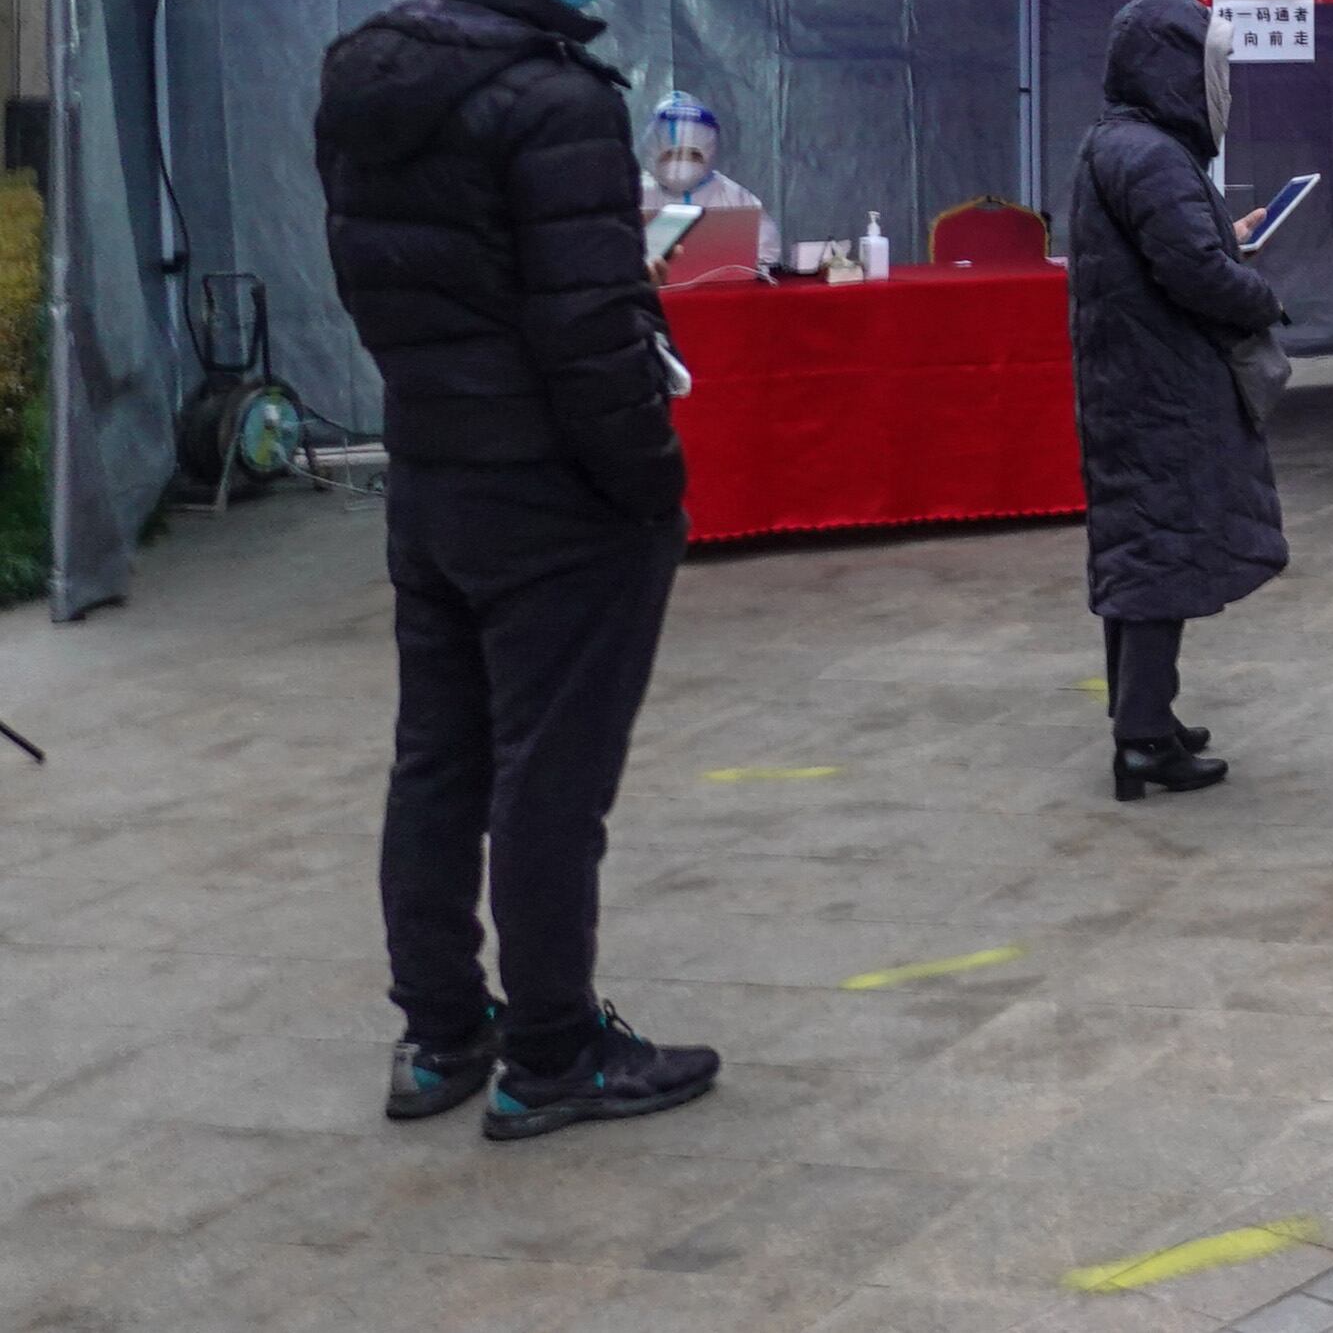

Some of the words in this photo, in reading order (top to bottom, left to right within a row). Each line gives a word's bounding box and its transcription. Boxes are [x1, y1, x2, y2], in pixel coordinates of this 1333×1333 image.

[1219, 6, 1309, 22] 持一码通者
[1244, 31, 1309, 47] 向前走
